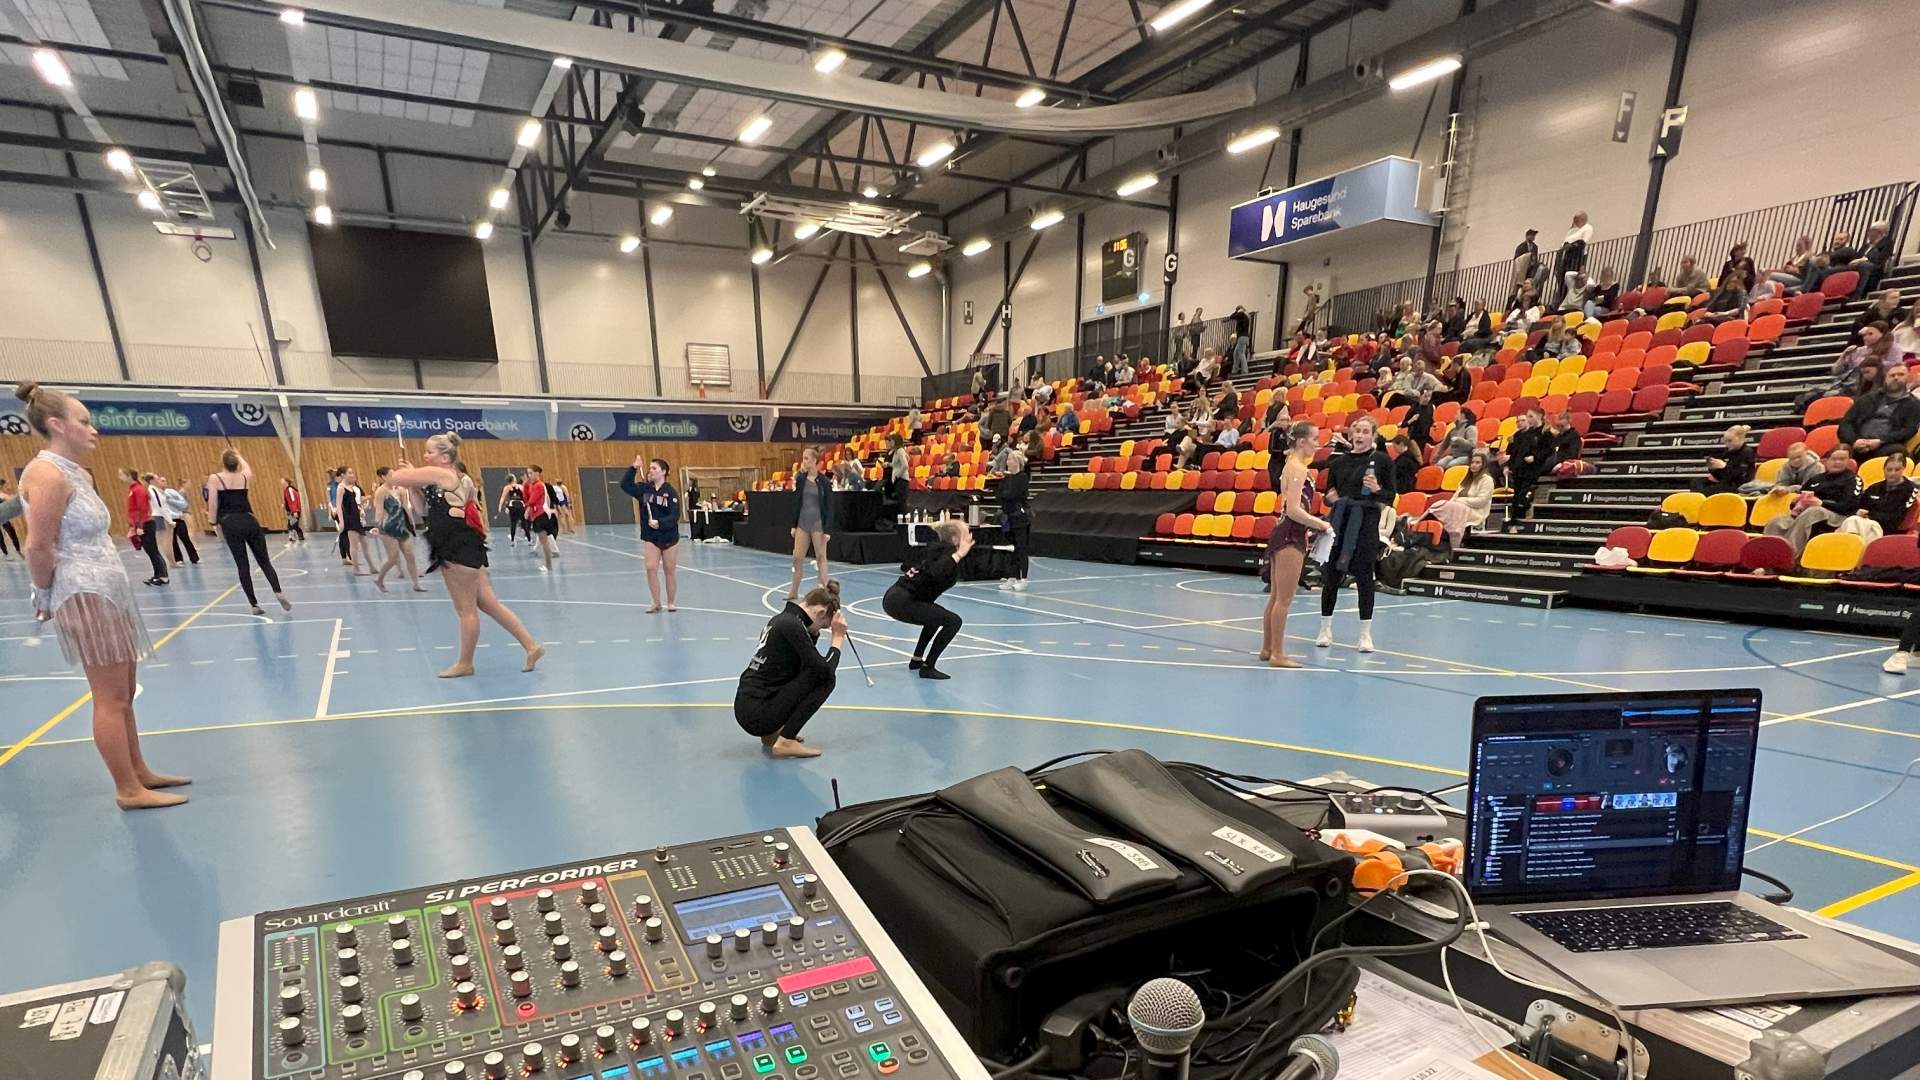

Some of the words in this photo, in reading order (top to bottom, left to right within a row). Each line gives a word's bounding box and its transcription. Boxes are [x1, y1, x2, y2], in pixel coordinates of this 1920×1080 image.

[1618, 92, 1634, 123] F
[1292, 187, 1347, 213] Haugesund
[1291, 207, 1341, 231] Sparebank
[1123, 249, 1135, 267] G
[1165, 254, 1177, 272] G
[964, 302, 973, 316] H
[1002, 304, 1011, 319] H
[357, 416, 440, 433] Haugesund
[445, 417, 519, 434] Sparebank
[630, 417, 697, 434] #einforalle
[458, 858, 639, 899] PERFORMER
[265, 900, 390, 931] Soundcraft
